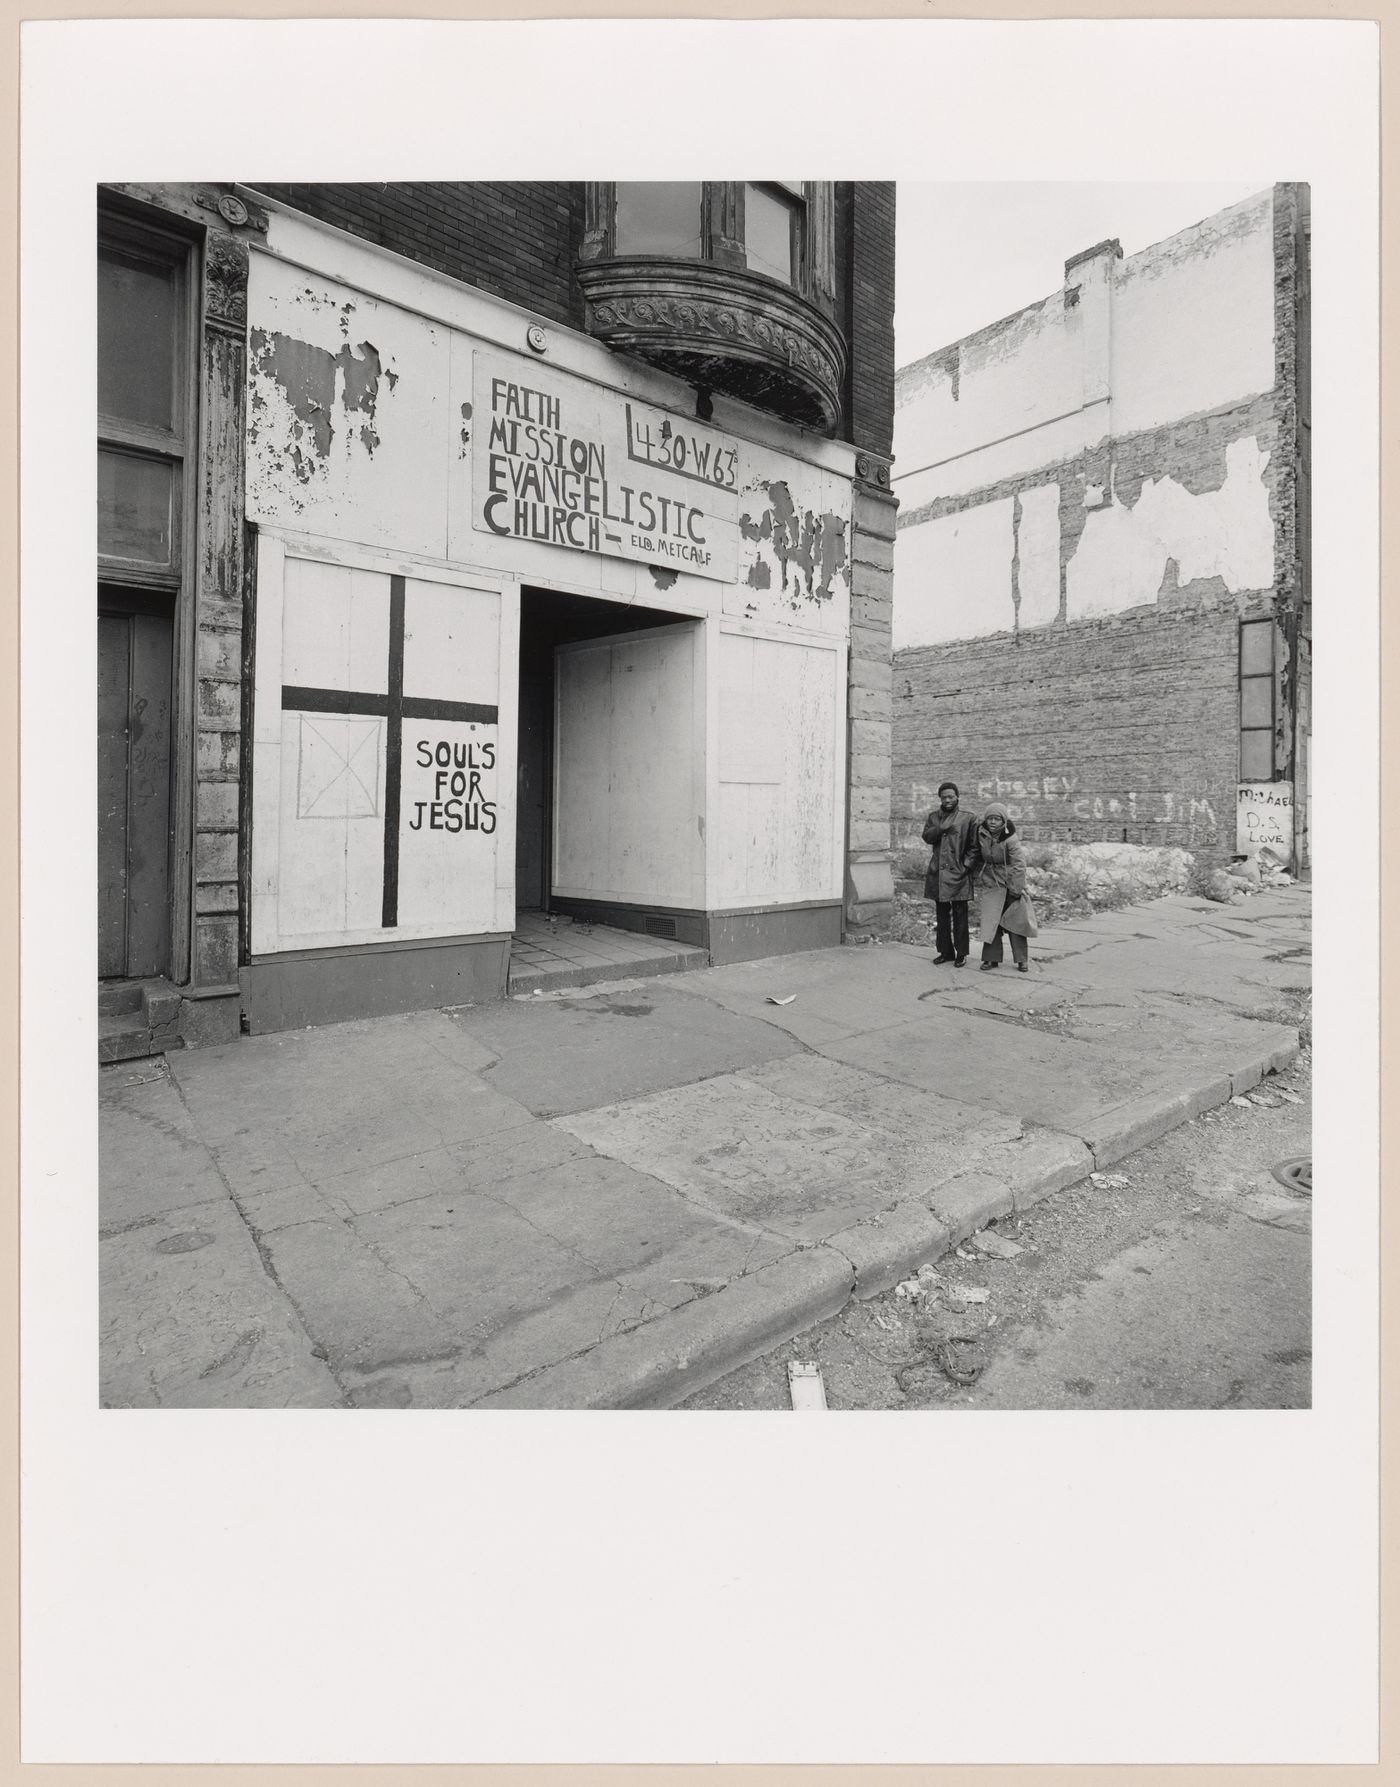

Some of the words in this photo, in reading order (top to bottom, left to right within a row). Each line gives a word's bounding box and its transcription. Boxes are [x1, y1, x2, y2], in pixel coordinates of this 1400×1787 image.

[492, 377, 560, 430] FAITH
[489, 416, 605, 480] MISSION
[489, 453, 706, 545] EVANGELISTIC
[658, 538, 712, 566] METCALF
[435, 771, 486, 802] FOR
[409, 799, 497, 834] JESUS
[1249, 830, 1285, 843] LOVE
